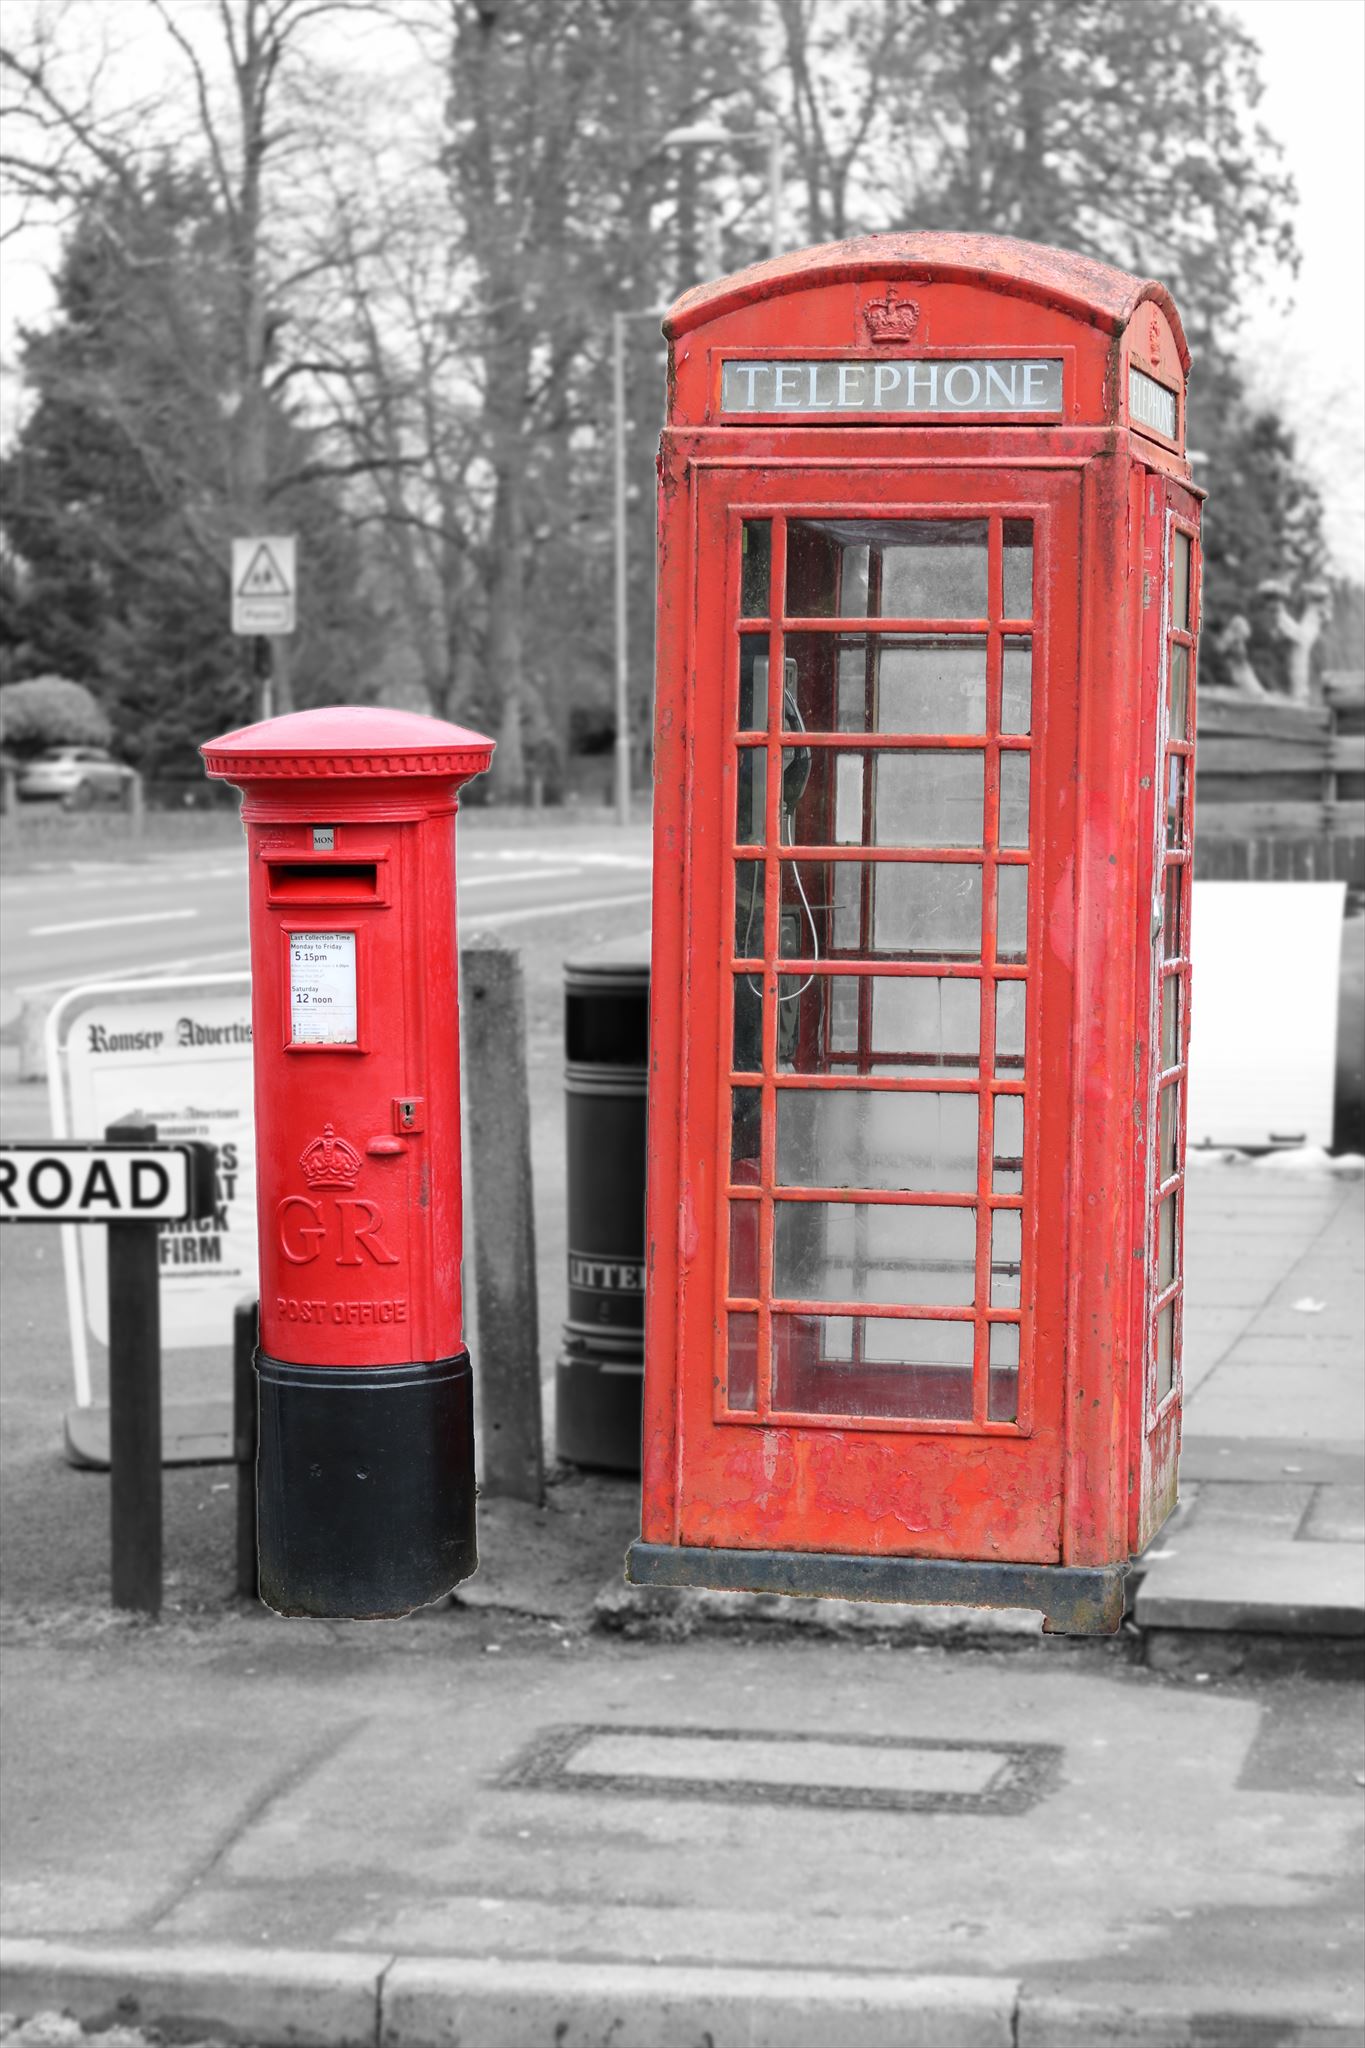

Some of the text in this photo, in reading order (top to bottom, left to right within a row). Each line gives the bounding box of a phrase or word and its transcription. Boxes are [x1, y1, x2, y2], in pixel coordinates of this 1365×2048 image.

[736, 364, 1049, 407] TELEPHONE
[295, 951, 328, 962] 5.15pm
[291, 985, 319, 993] Saturday
[296, 993, 309, 1004] 12
[88, 1023, 164, 1054] Romsey
[0, 1157, 170, 1210] ROAD
[275, 1194, 400, 1266] GR
[158, 1235, 222, 1265] FIRM
[277, 1297, 407, 1325] POST OFFICE
